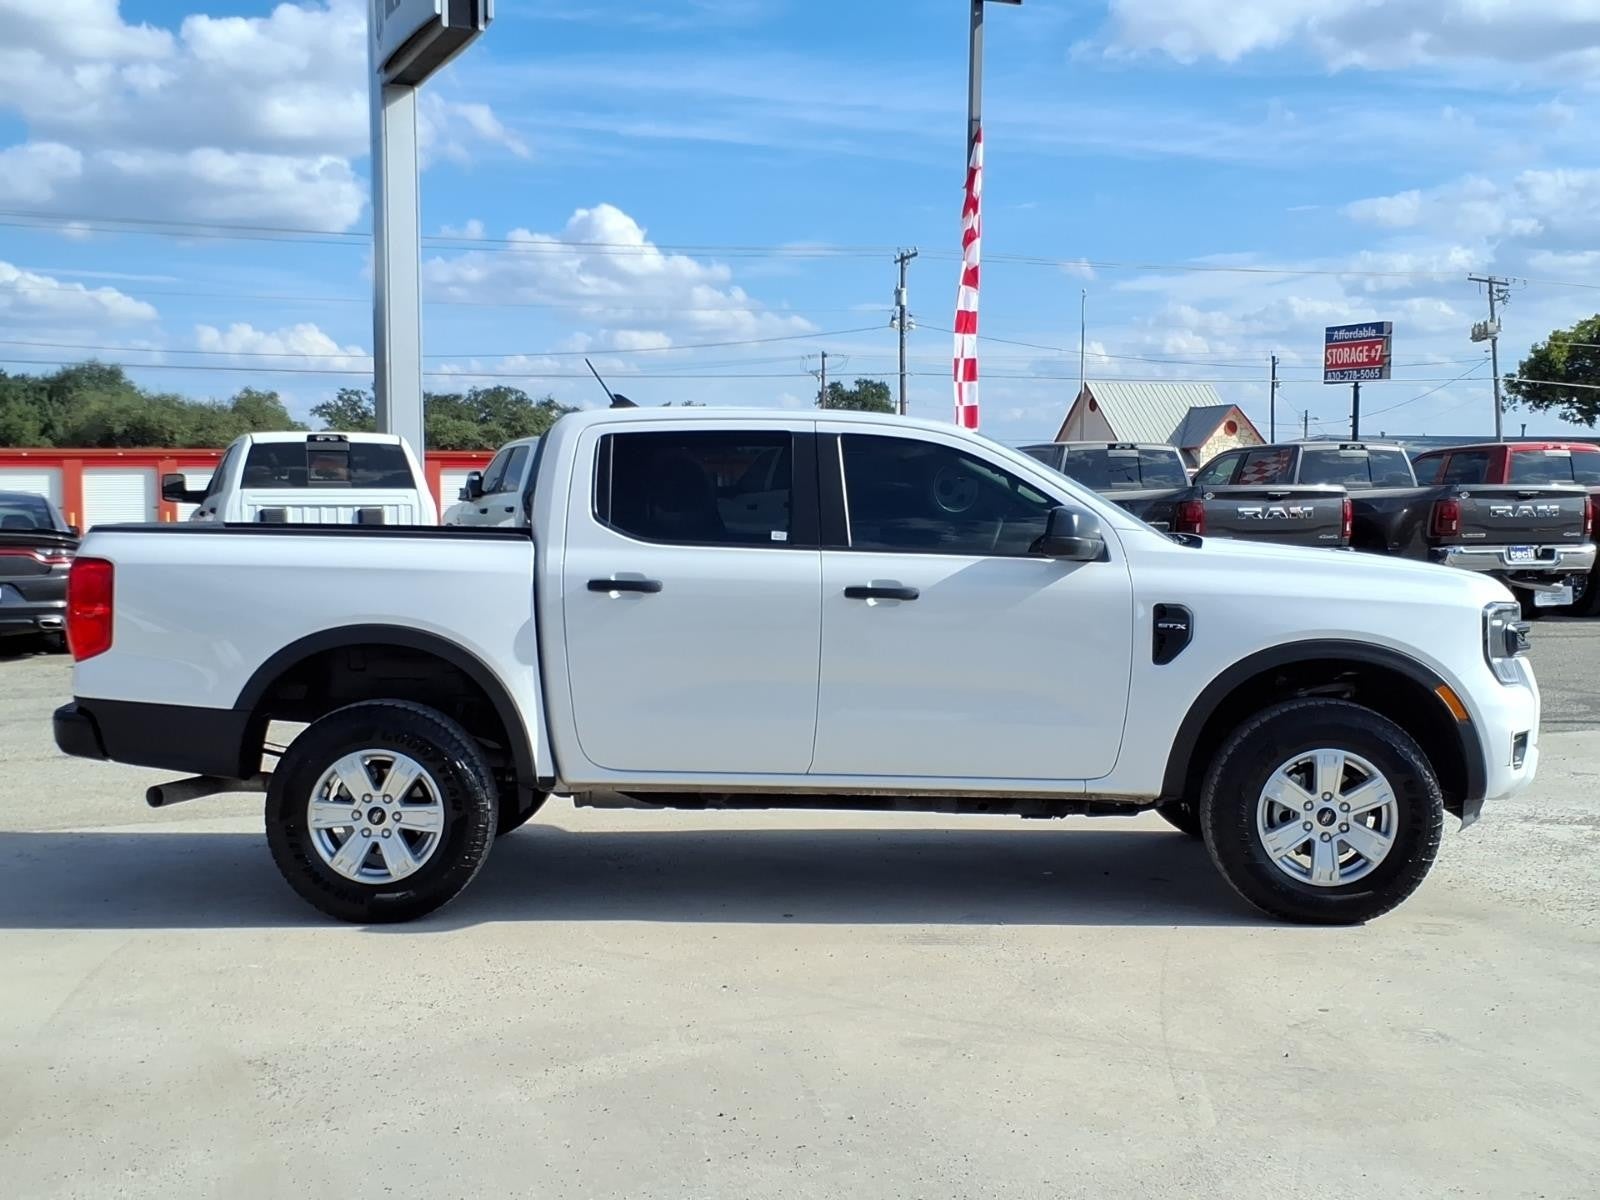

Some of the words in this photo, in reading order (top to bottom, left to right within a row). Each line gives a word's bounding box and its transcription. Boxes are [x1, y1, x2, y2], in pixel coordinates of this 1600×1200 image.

[1333, 327, 1376, 341] Affordable
[1327, 345, 1369, 365] STORAGE
[1237, 506, 1314, 520] RAM
[1490, 504, 1560, 518] RAM
